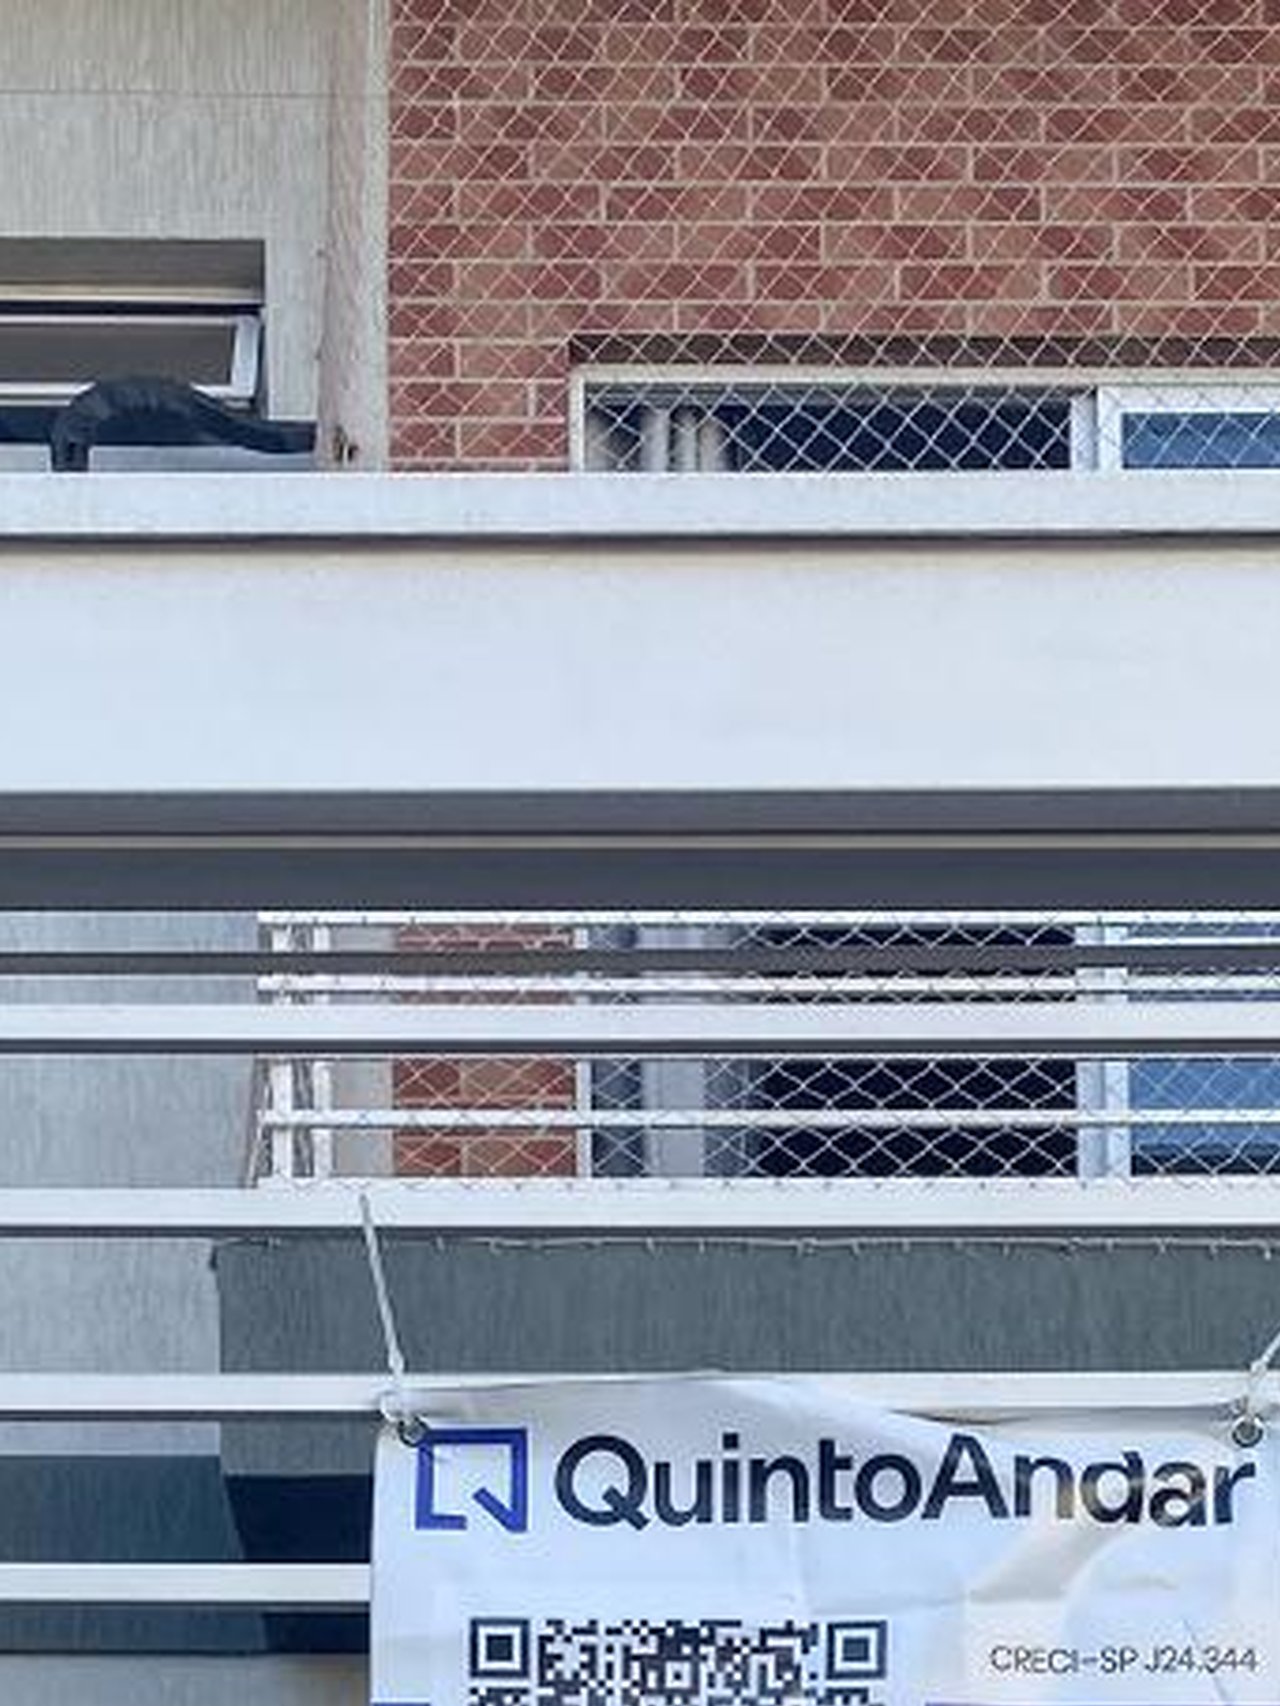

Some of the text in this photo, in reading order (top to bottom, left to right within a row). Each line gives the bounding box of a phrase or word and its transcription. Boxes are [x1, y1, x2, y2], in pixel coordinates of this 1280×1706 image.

[553, 1432, 1257, 1530] QuintoAndar
[989, 1645, 1258, 1675] CRECI-SP J24.344
